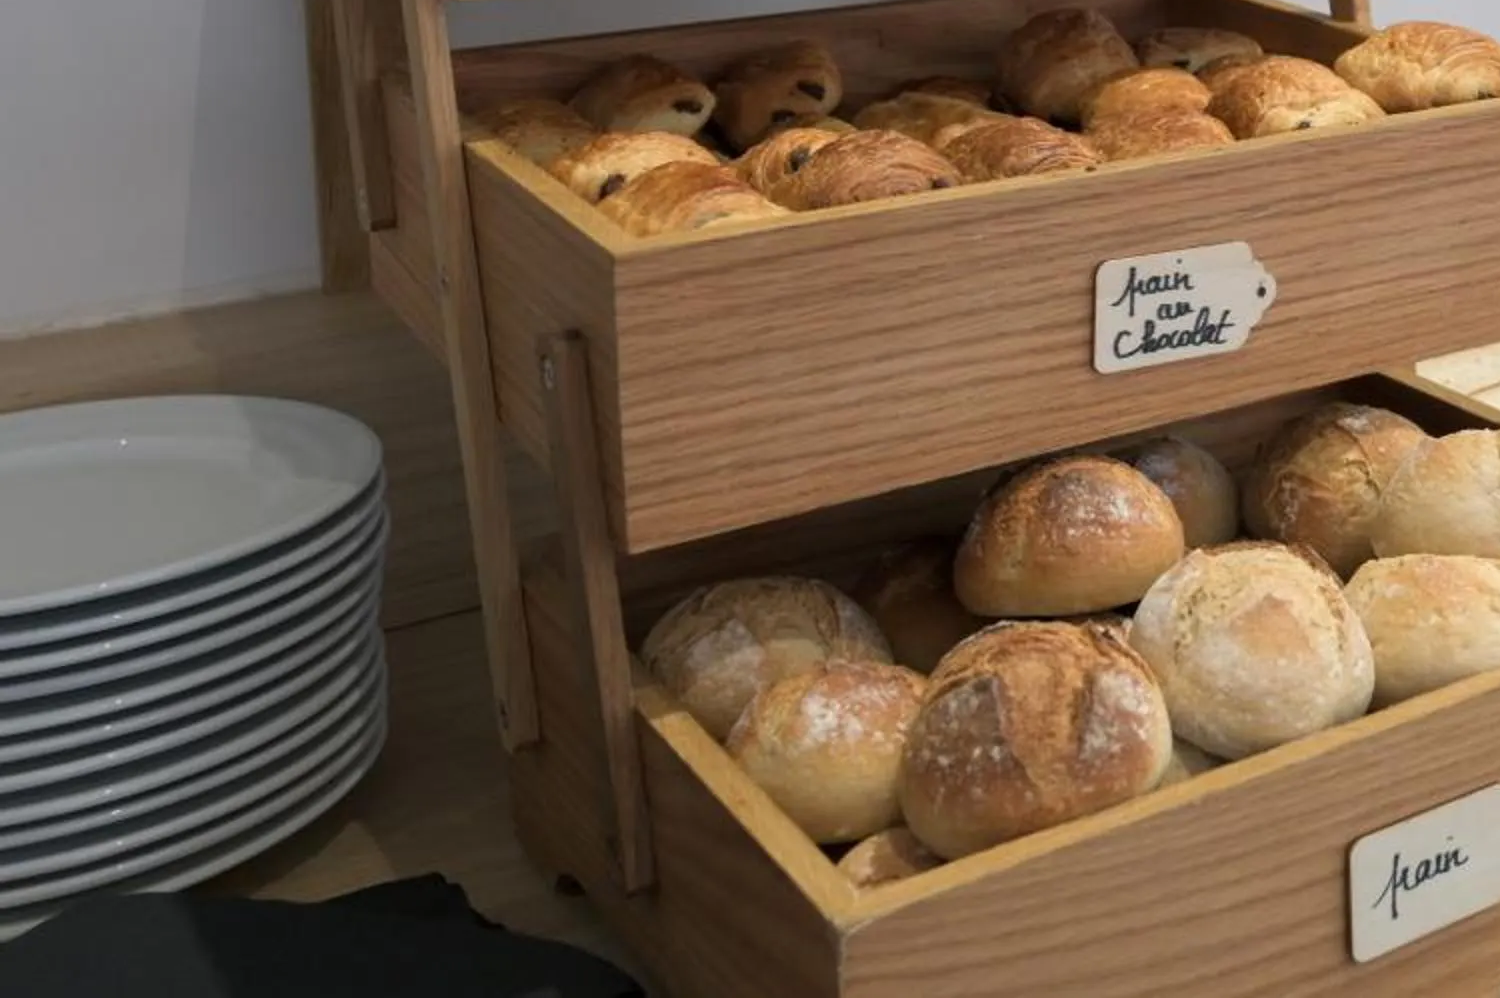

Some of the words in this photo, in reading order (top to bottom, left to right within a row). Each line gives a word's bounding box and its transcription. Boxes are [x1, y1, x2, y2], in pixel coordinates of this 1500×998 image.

[1110, 257, 1195, 317] pain
[1156, 301, 1194, 321] au
[1370, 834, 1470, 920] pain
